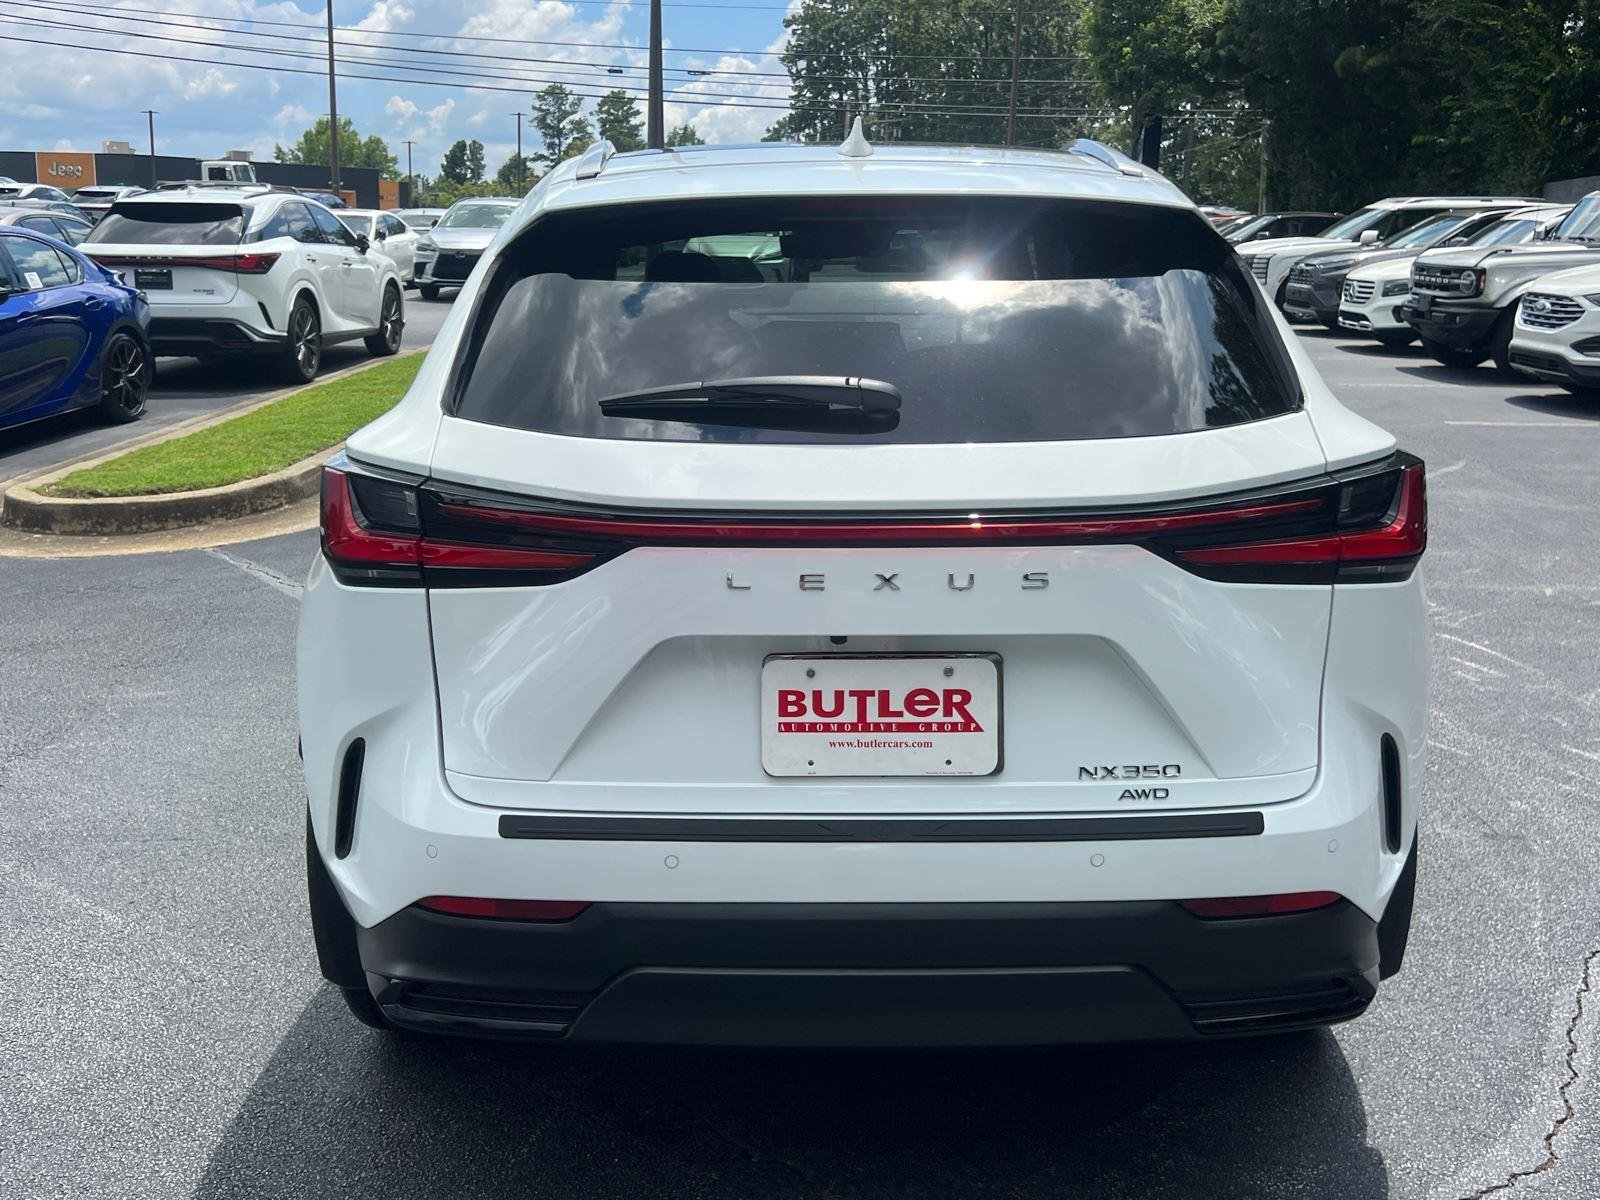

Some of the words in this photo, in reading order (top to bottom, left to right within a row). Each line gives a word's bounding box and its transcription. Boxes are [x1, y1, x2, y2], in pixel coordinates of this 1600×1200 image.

[48, 161, 83, 178] Jeep
[726, 571, 1050, 592] LEXUS
[778, 722, 898, 732] AUTOMOTIVE
[918, 722, 978, 732] GROUP
[828, 738, 934, 749] www.butlercars.com
[1118, 787, 1170, 801] AWD
